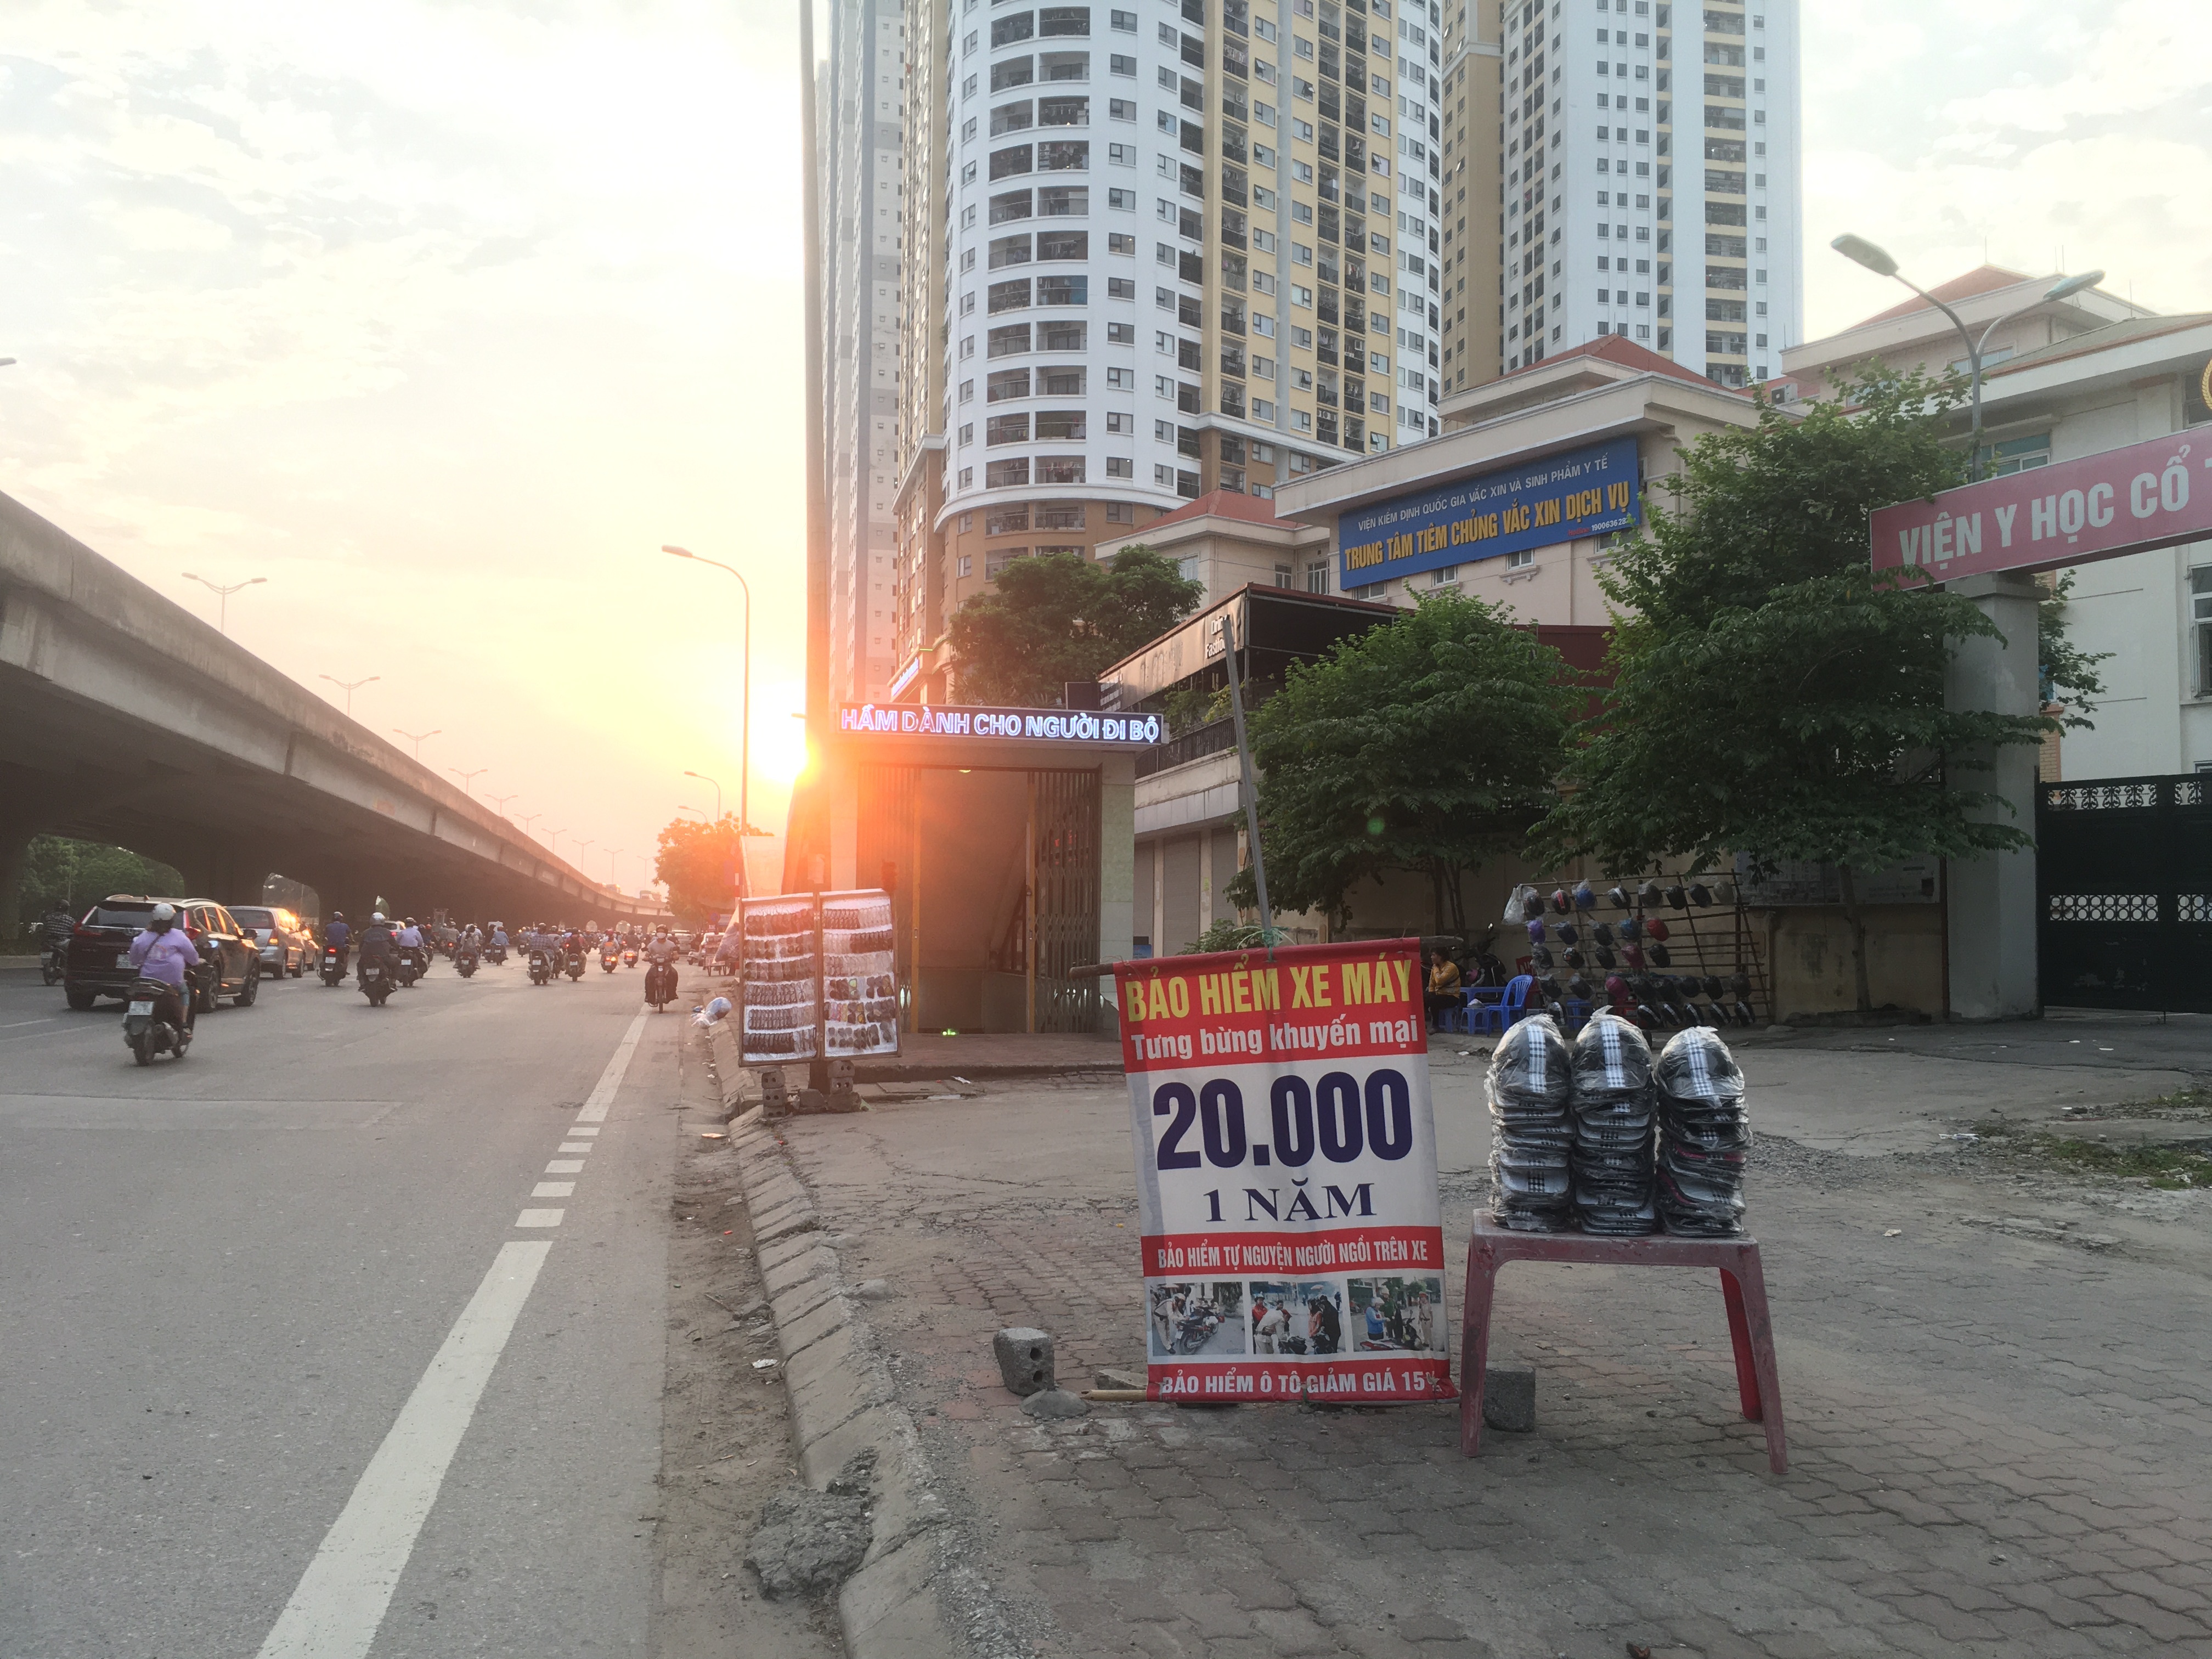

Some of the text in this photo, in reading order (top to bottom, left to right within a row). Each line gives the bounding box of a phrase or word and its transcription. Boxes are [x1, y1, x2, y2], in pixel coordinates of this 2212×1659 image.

[1358, 452, 1608, 531] VIỆN KIỂM ĐỊNH QUỐC GIA VẮC XIN VÀ SINH PHẨM Y TẾ
[1899, 444, 2191, 570] VIỆN Y HỌC CỔ
[1345, 480, 1629, 571] TRUNG TÂM TIÊM CHỦNG VẮC XIN DỊCH VỤ
[842, 704, 1159, 743] HẦM DÀNH CHO NGƯỜI ĐI BỘ
[1125, 952, 1413, 1023] BẢO HIỂM XE MÁY
[1131, 1013, 1418, 1060] Tưng bừng khuyến mại
[1153, 1068, 1413, 1170] 20.000
[1204, 1177, 1376, 1222] 1 NĂM
[1158, 1234, 1427, 1270] BẢO HIỂM TỰ NGUYỆN NGƯỜI NGỒI TRÊN XE
[1162, 1369, 1199, 1393] BẢO
[1205, 1367, 1253, 1392] HIỂM
[1260, 1370, 1272, 1392] Ô
[1278, 1370, 1301, 1393] TÔ
[1306, 1367, 1357, 1393] GIẢM
[1363, 1367, 1396, 1391] GIÁ
